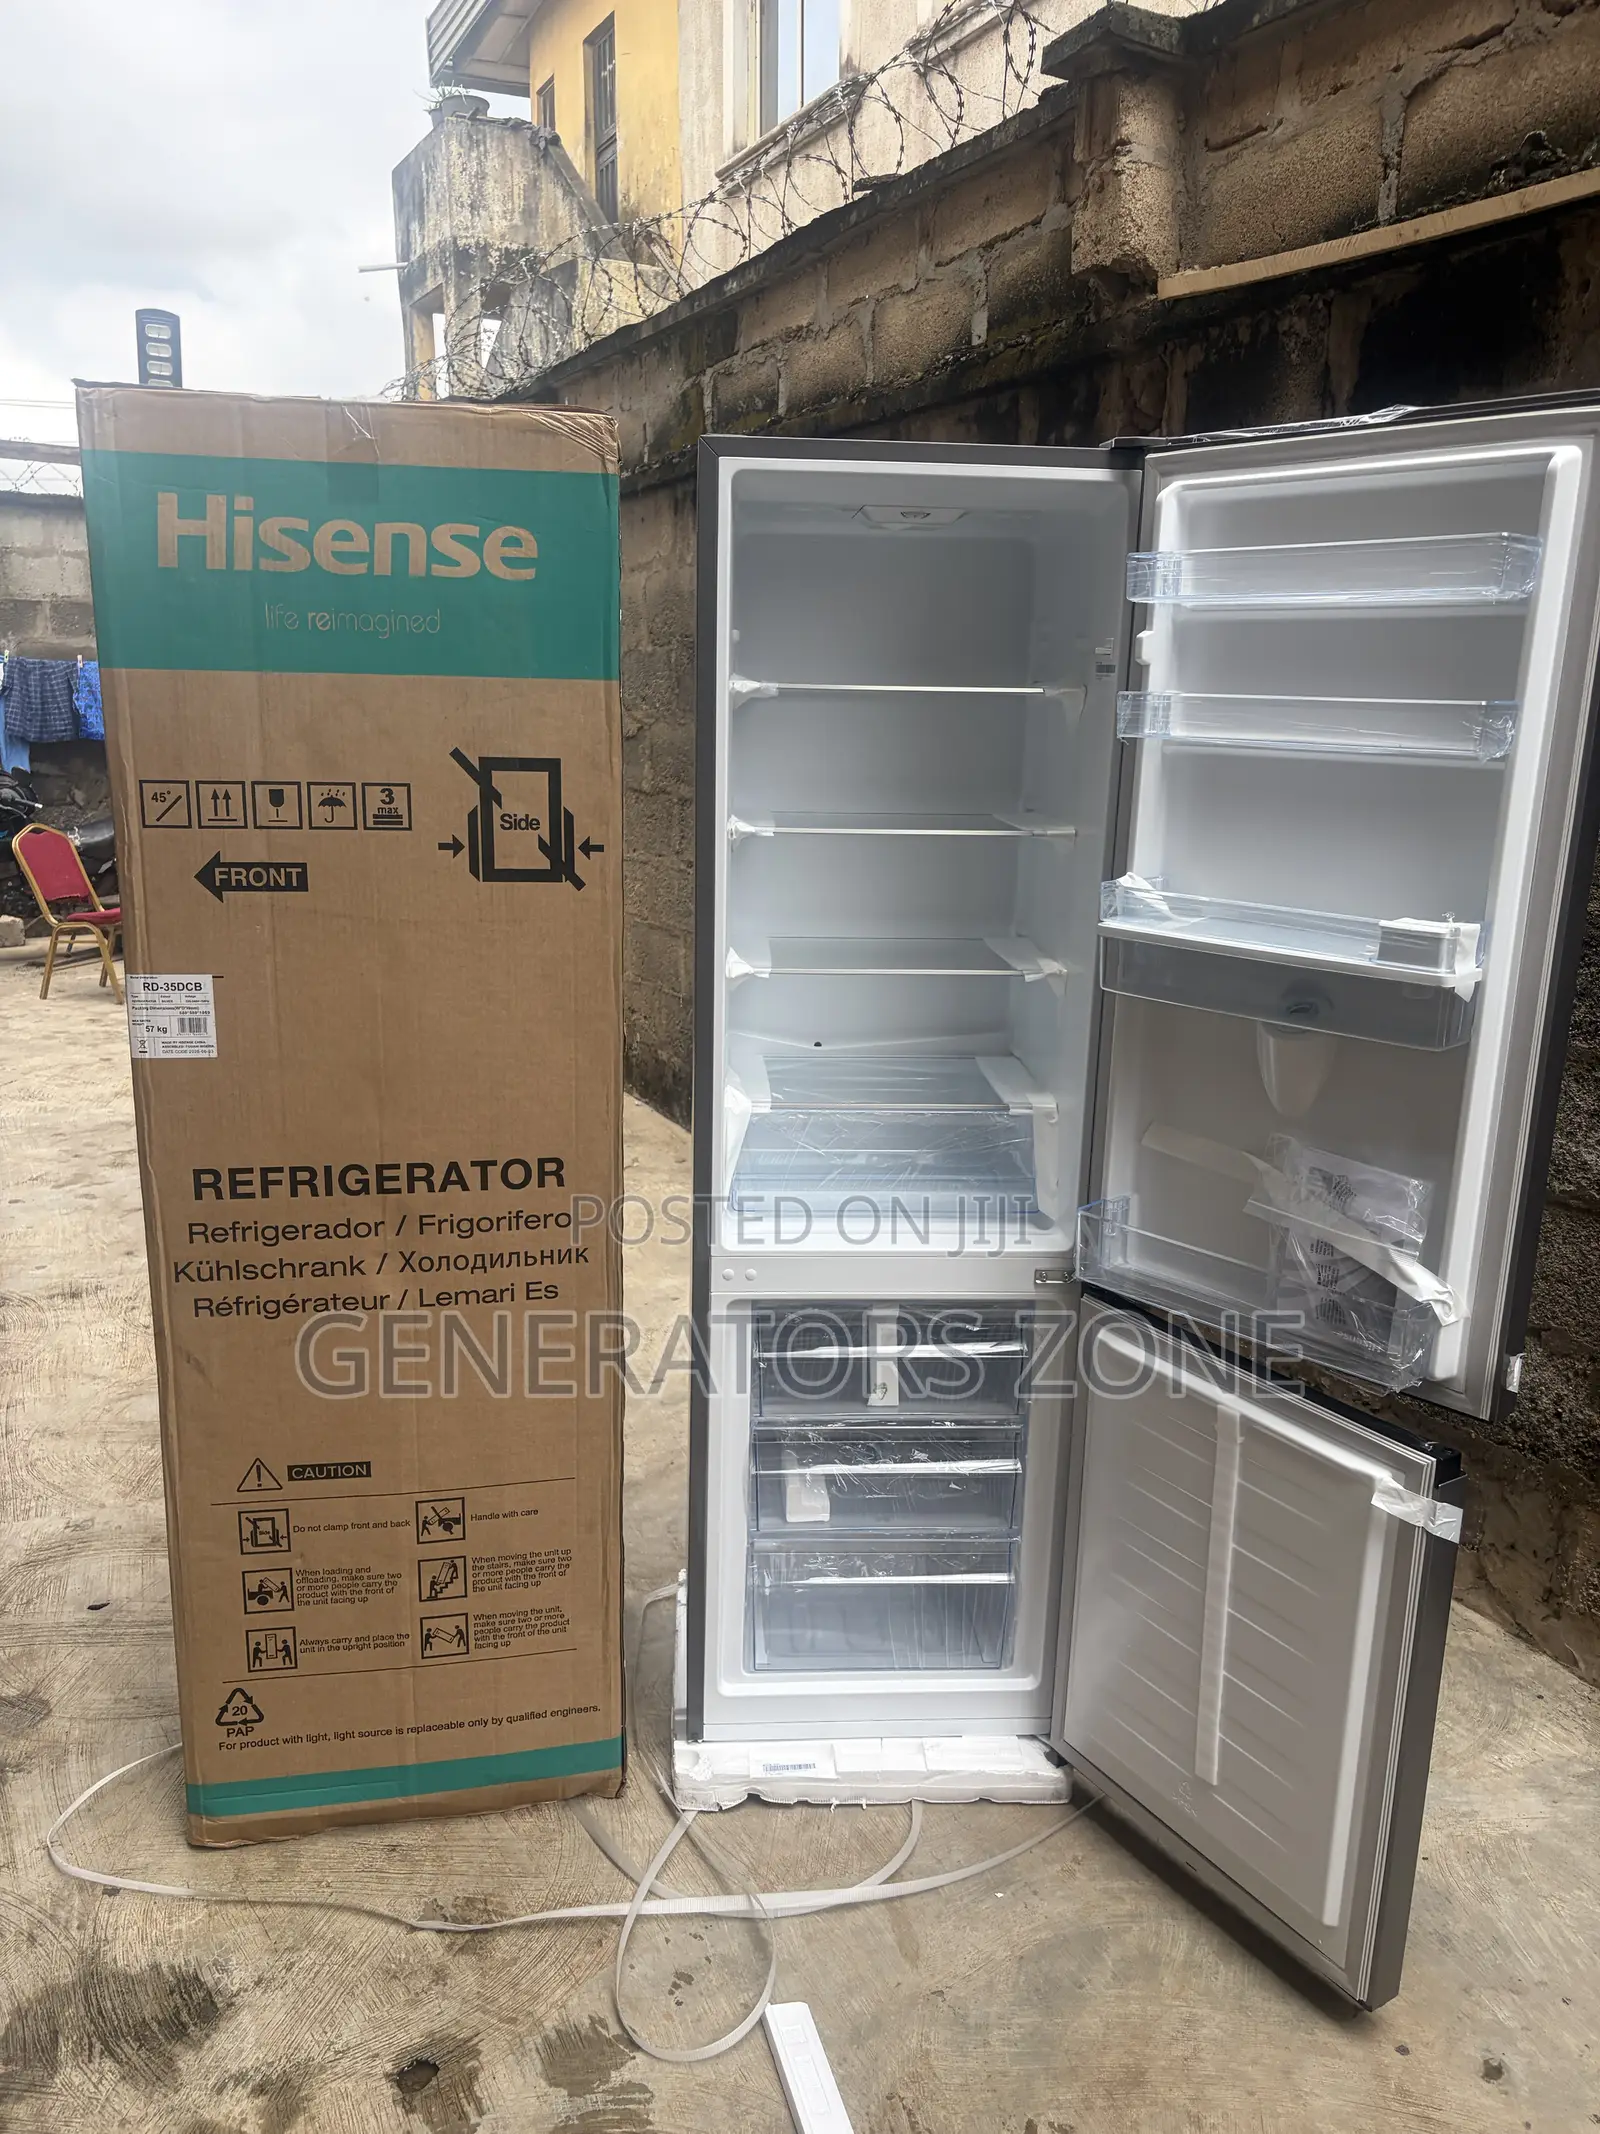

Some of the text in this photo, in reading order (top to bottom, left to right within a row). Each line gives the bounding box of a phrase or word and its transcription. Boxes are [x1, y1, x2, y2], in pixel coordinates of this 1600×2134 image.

[157, 492, 538, 580] Hisense
[265, 603, 440, 638] life reimagined
[380, 788, 394, 804] 3
[377, 806, 398, 814] max
[500, 813, 540, 832] Side
[215, 868, 301, 886] FRONT
[143, 982, 202, 991] RD-35DCB
[192, 1157, 565, 1200] REFRIGERATOR
[188, 1210, 572, 1246] Refrigerador / Frigorifero
[174, 1247, 589, 1283] Kühlschrank / Холодильник
[194, 1281, 559, 1320] Réfrigérateur / Lemari Es
[292, 1464, 367, 1479] CAUTION
[471, 1512, 499, 1522] Handle
[502, 1510, 518, 1519] with
[323, 1524, 348, 1532] clamp
[351, 1522, 371, 1530] front
[373, 1521, 387, 1529] and
[391, 1520, 410, 1528] back
[472, 1556, 495, 1564] When
[498, 1553, 527, 1561] moving
[545, 1549, 559, 1557] unit
[514, 1559, 535, 1567] make
[473, 1577, 502, 1586] product
[559, 1569, 566, 1577] of
[506, 1567, 532, 1576] people
[332, 1582, 359, 1590] people
[488, 1583, 502, 1591] unit
[505, 1581, 528, 1590] facing
[297, 1591, 328, 1600] product
[331, 1589, 347, 1597] with
[331, 1596, 355, 1604] facing
[473, 1613, 497, 1621] When
[500, 1611, 528, 1619] moving
[474, 1627, 500, 1636] people
[541, 1619, 570, 1628] product
[300, 1638, 329, 1646] Always
[474, 1634, 490, 1642] with
[343, 1643, 371, 1651] upright
[374, 1641, 404, 1649] position
[475, 1641, 498, 1649] facing
[232, 1706, 247, 1716] 20
[219, 1704, 600, 1751] For product with light, light source is replaceable only by qualified engineers.
[227, 1726, 254, 1737] PAP
